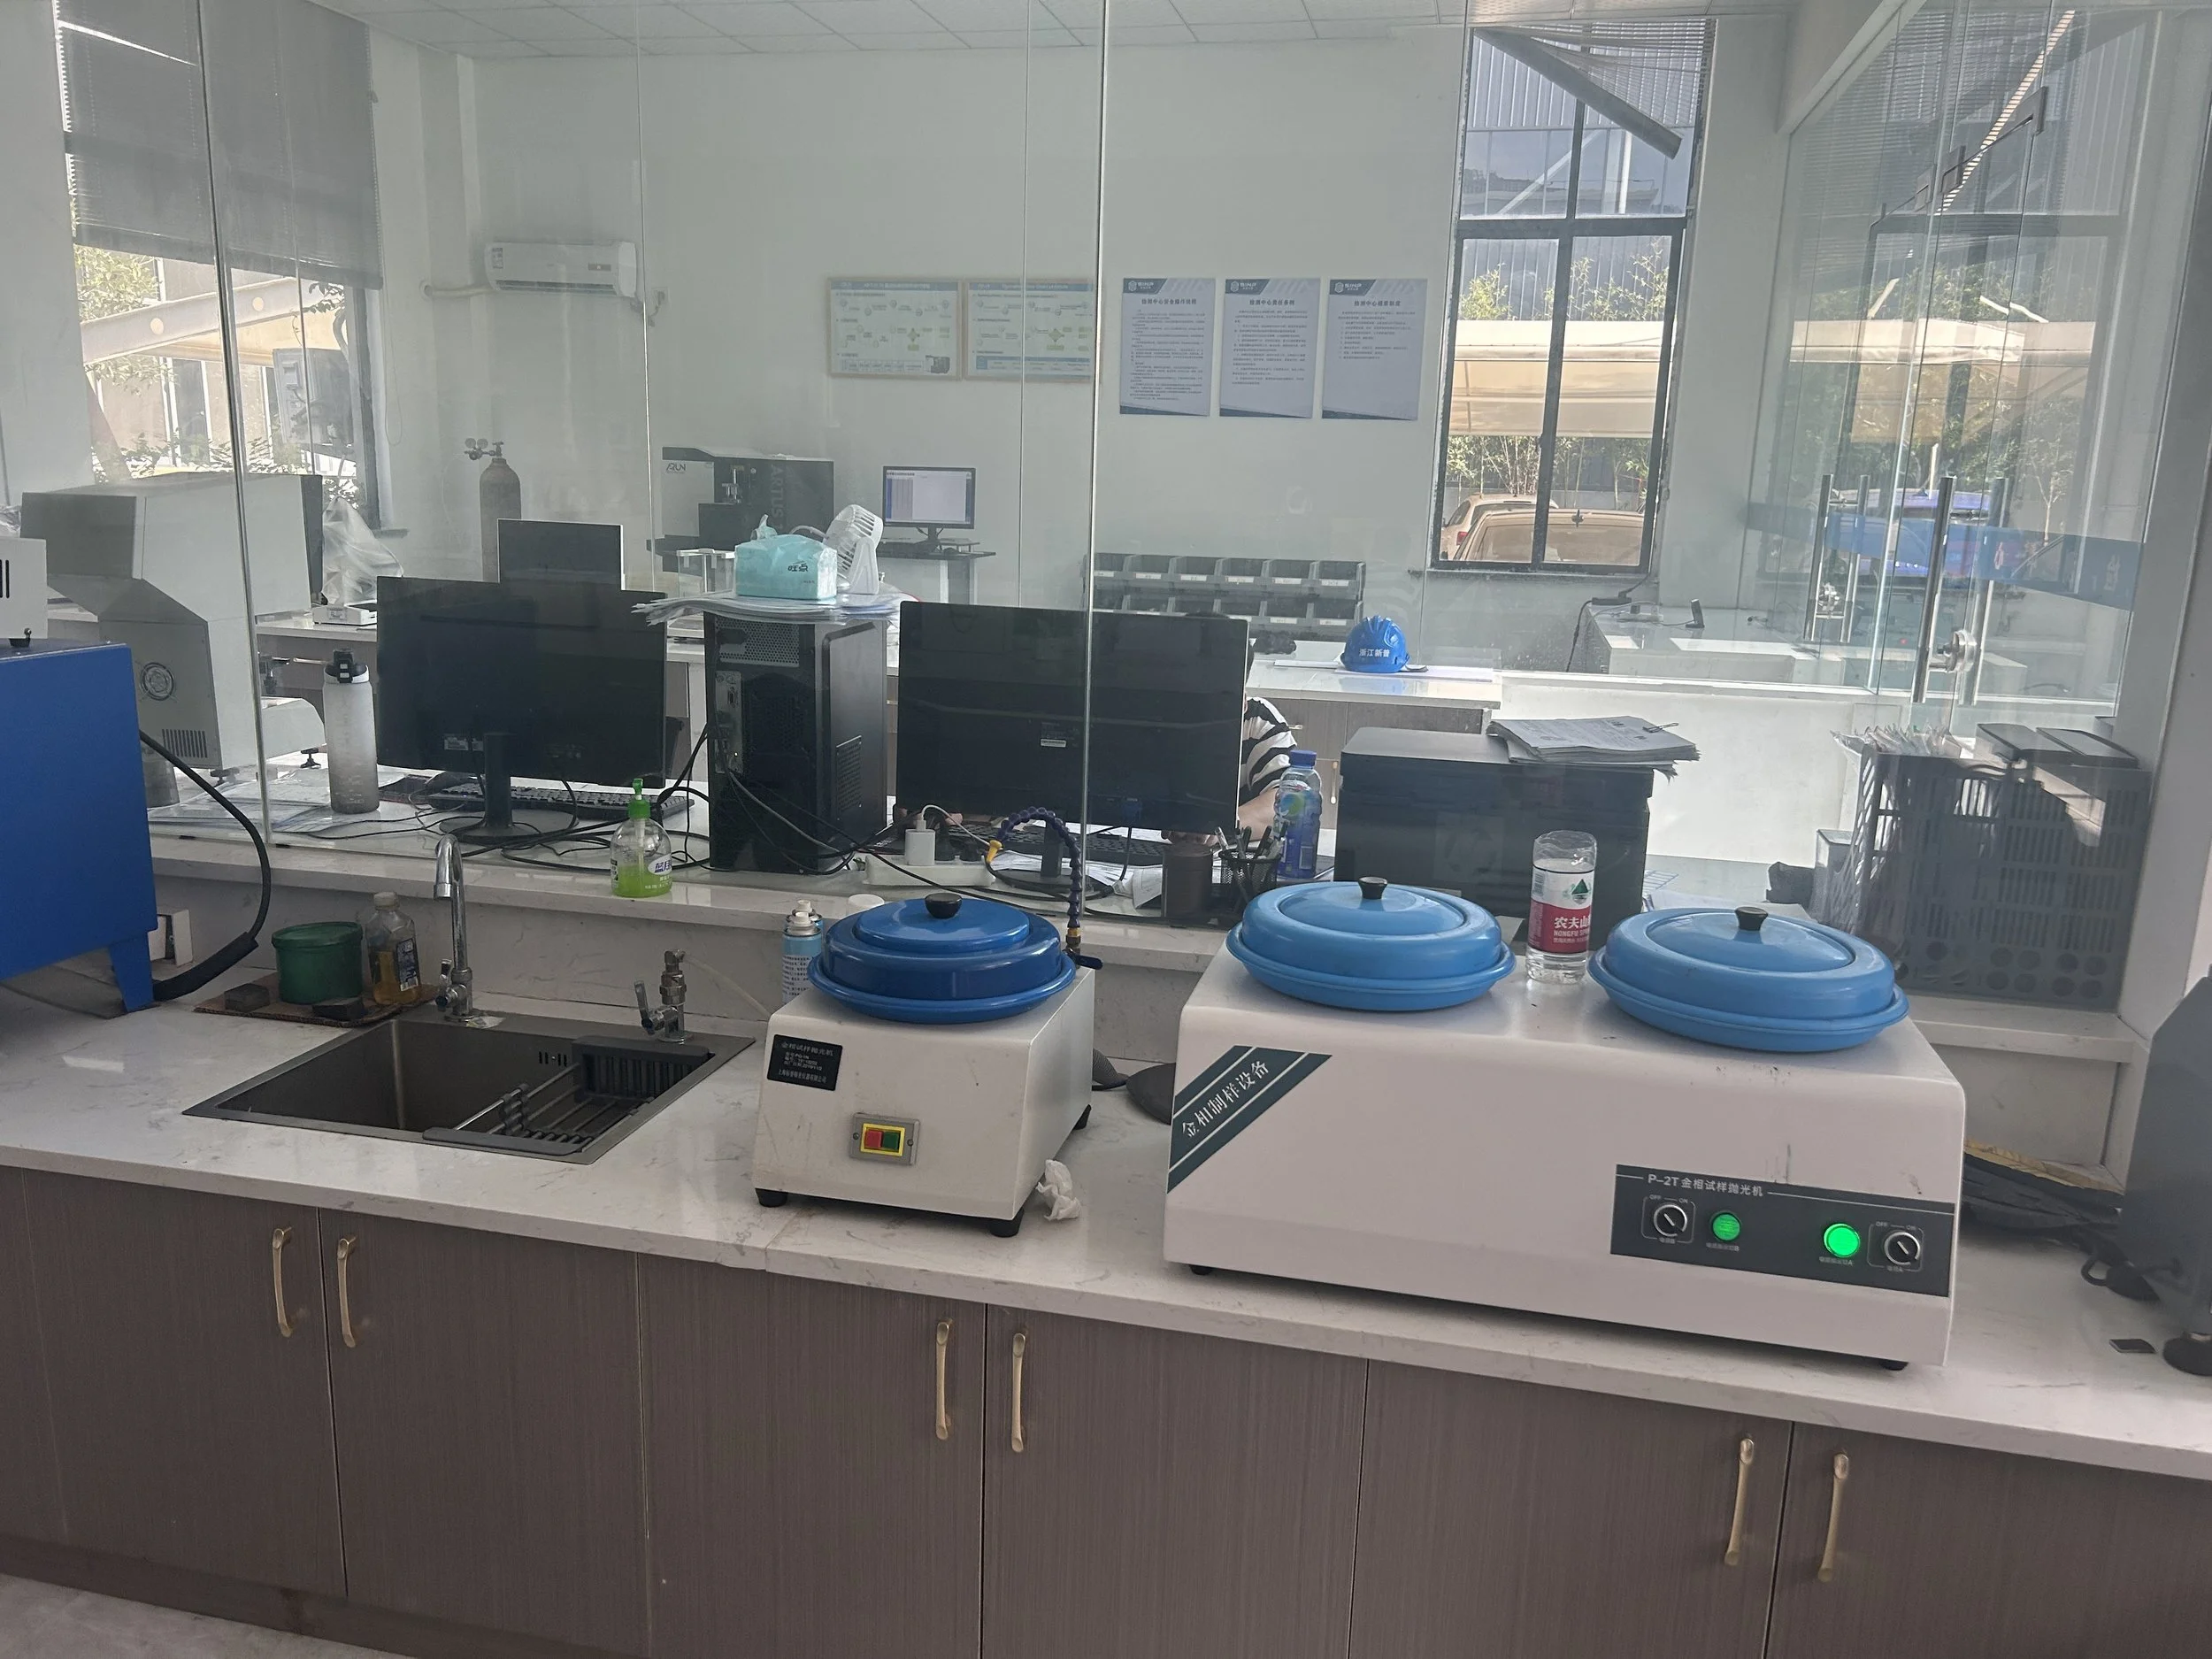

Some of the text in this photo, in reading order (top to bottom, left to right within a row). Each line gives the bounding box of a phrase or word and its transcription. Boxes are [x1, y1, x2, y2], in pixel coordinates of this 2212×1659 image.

[1181, 1060, 1270, 1138] 金相制样设备
